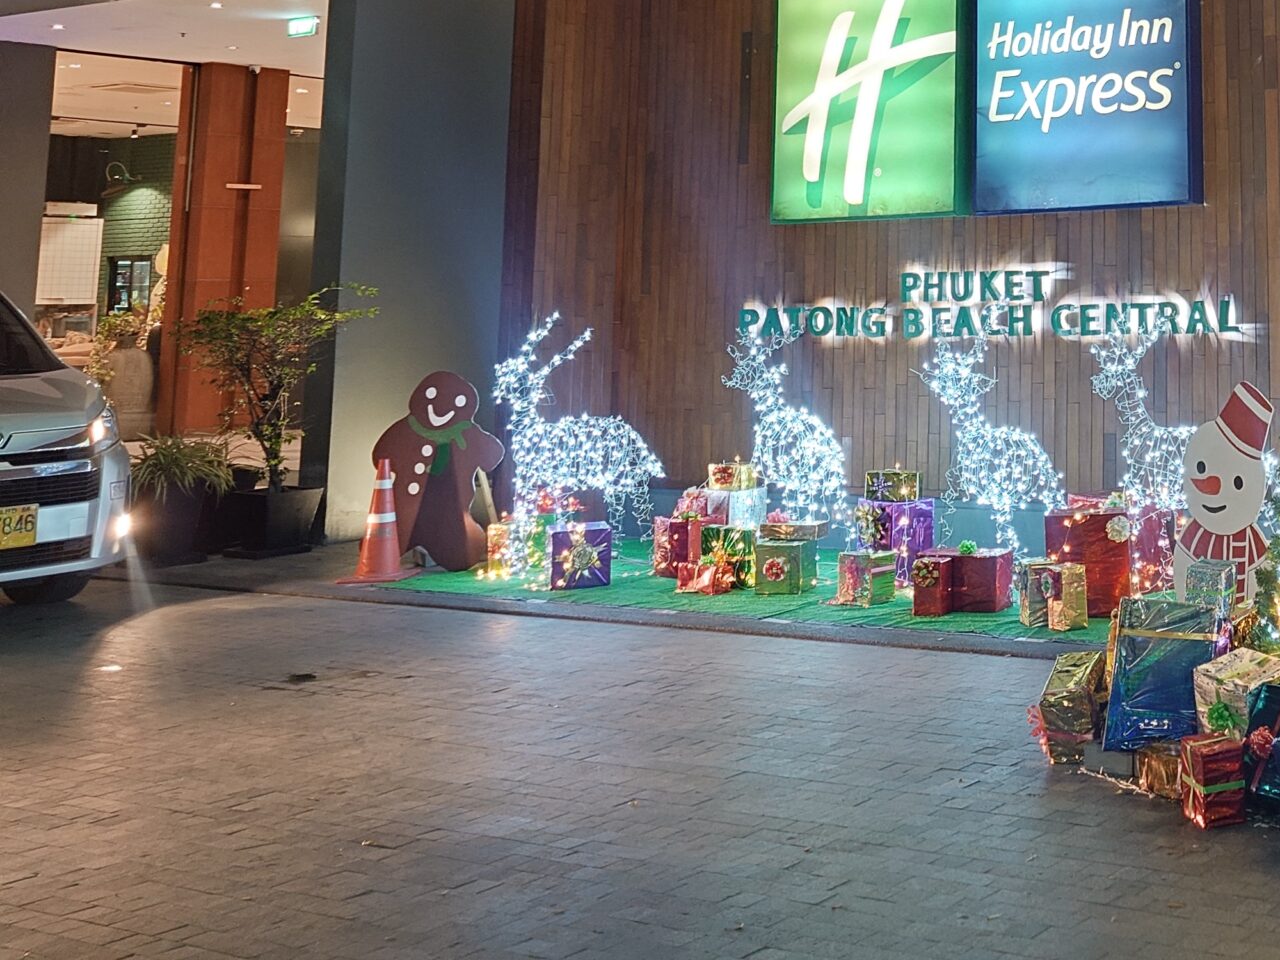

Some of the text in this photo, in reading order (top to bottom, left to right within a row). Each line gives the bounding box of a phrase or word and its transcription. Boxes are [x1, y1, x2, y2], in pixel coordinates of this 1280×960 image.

[987, 8, 1173, 59] Holiday Inn
[988, 67, 1175, 134] Express
[901, 270, 1050, 303] PHUKET
[738, 299, 1242, 338] PATONG BEACH CENTRAL
[0, 514, 35, 535] 846
